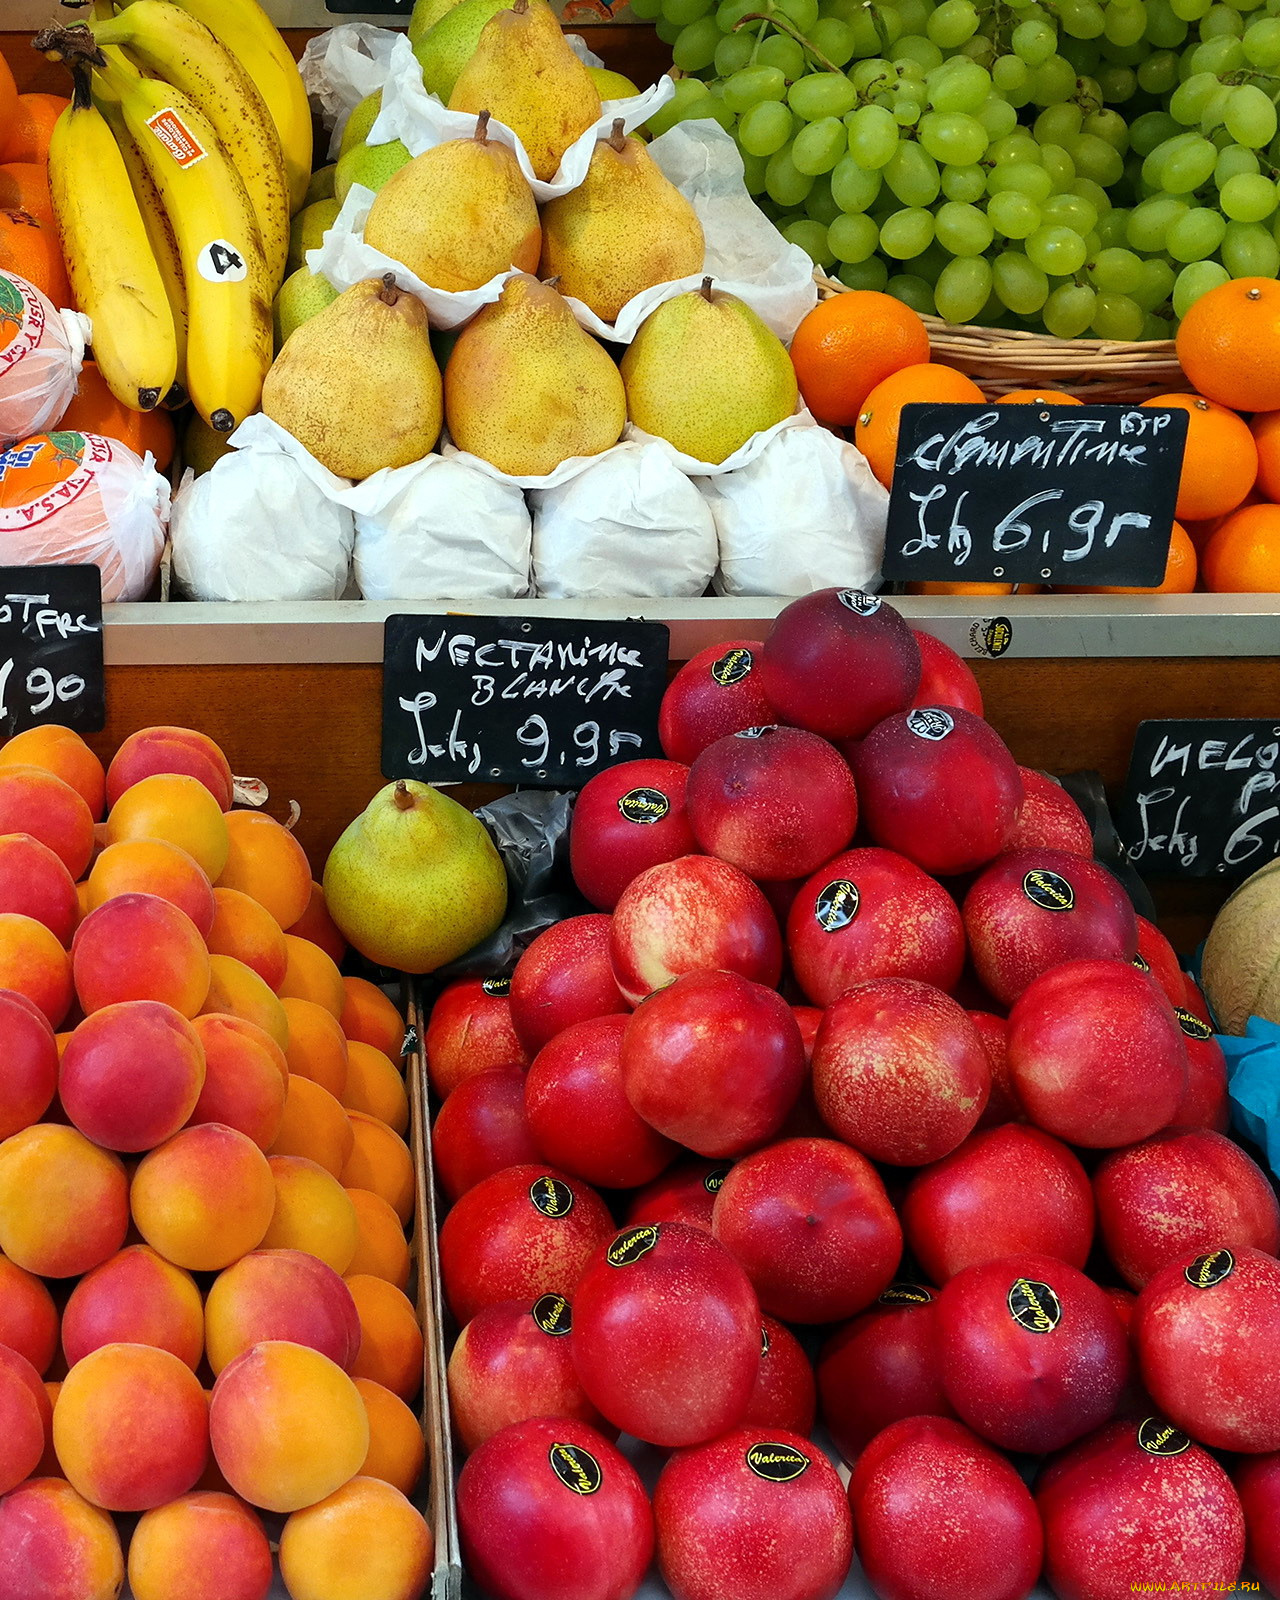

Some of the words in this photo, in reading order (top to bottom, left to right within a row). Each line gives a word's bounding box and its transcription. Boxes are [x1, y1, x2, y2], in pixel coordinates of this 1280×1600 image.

[154, 124, 186, 160] Banane
[210, 243, 243, 275] 4
[7, 453, 18, 466] ET
[14, 443, 45, 467] TOI
